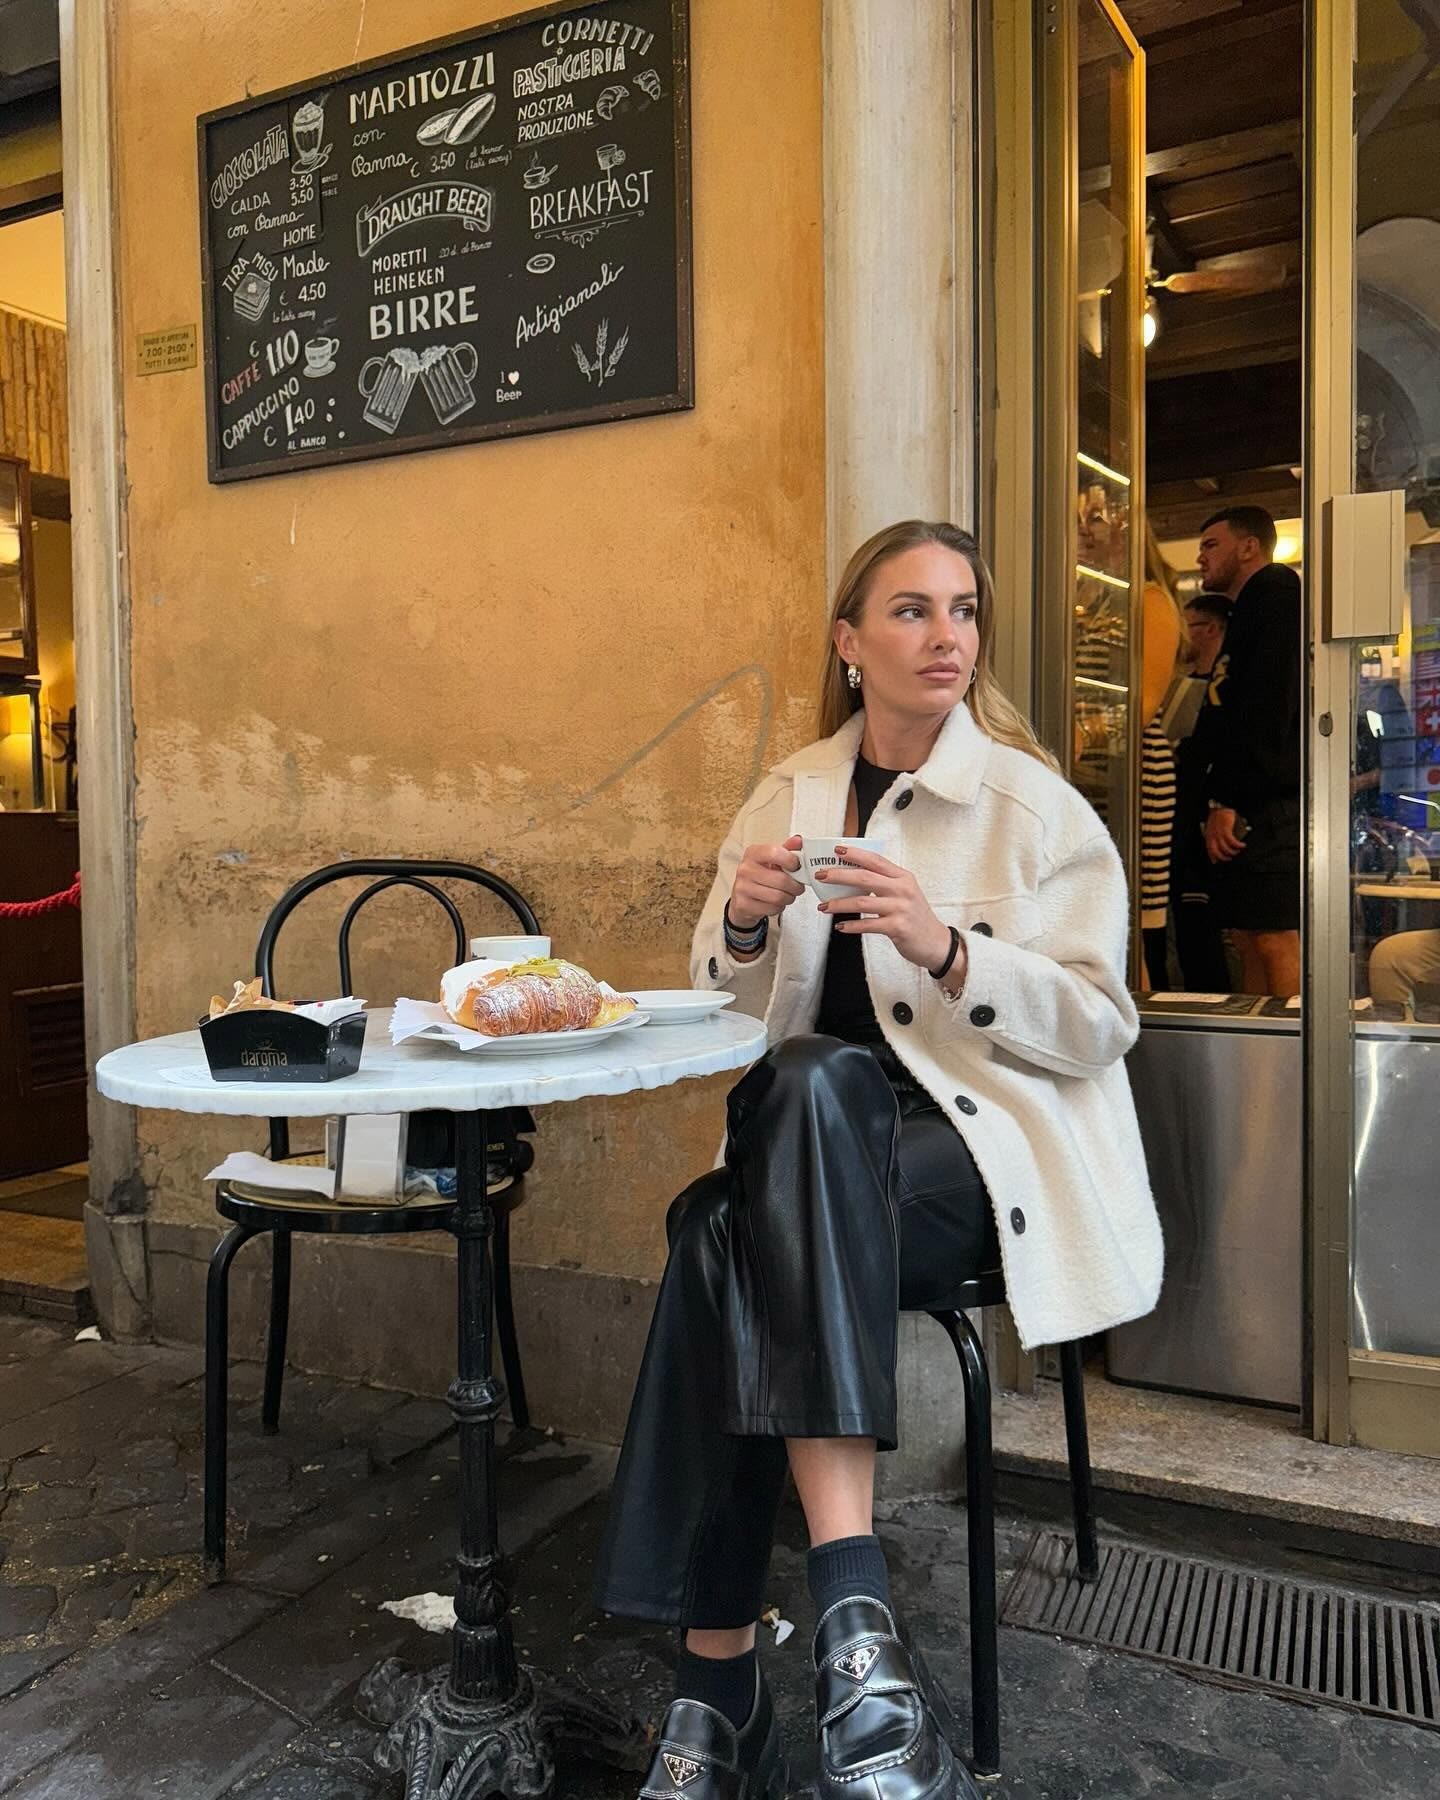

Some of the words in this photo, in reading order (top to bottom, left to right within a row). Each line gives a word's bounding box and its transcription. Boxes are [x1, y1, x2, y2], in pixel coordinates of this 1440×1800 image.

[542, 18, 655, 56] CORNETTI
[350, 52, 495, 124] MARITOZZI
[517, 93, 574, 121] NOSTRA
[352, 128, 386, 147] con
[518, 109, 594, 142] PRODUZIONE
[210, 124, 290, 209] CIOCCOLATA
[351, 153, 413, 177] Panna
[231, 192, 271, 215] CALDA
[530, 170, 653, 229] BREAKFAST
[227, 225, 249, 239] con
[255, 211, 304, 231] Panna
[368, 189, 444, 245] DRAUGHT
[446, 188, 488, 218] BEER
[283, 224, 316, 248] HOME
[222, 257, 250, 292] TIRA
[251, 251, 278, 281] MISU
[283, 250, 330, 280] Made
[372, 247, 427, 274] MORETTI
[374, 266, 445, 296] HEINEKEN
[370, 285, 479, 340] BIRRE
[516, 262, 624, 348] Artigianali
[222, 361, 260, 404] CAFFE
[500, 371, 505, 383] I
[496, 389, 522, 402] Beer
[222, 377, 299, 450] CAPPUCCINO
[287, 441, 297, 451] AL
[241, 1049, 288, 1066] daroma
[670, 1757, 697, 1771] PRADA
